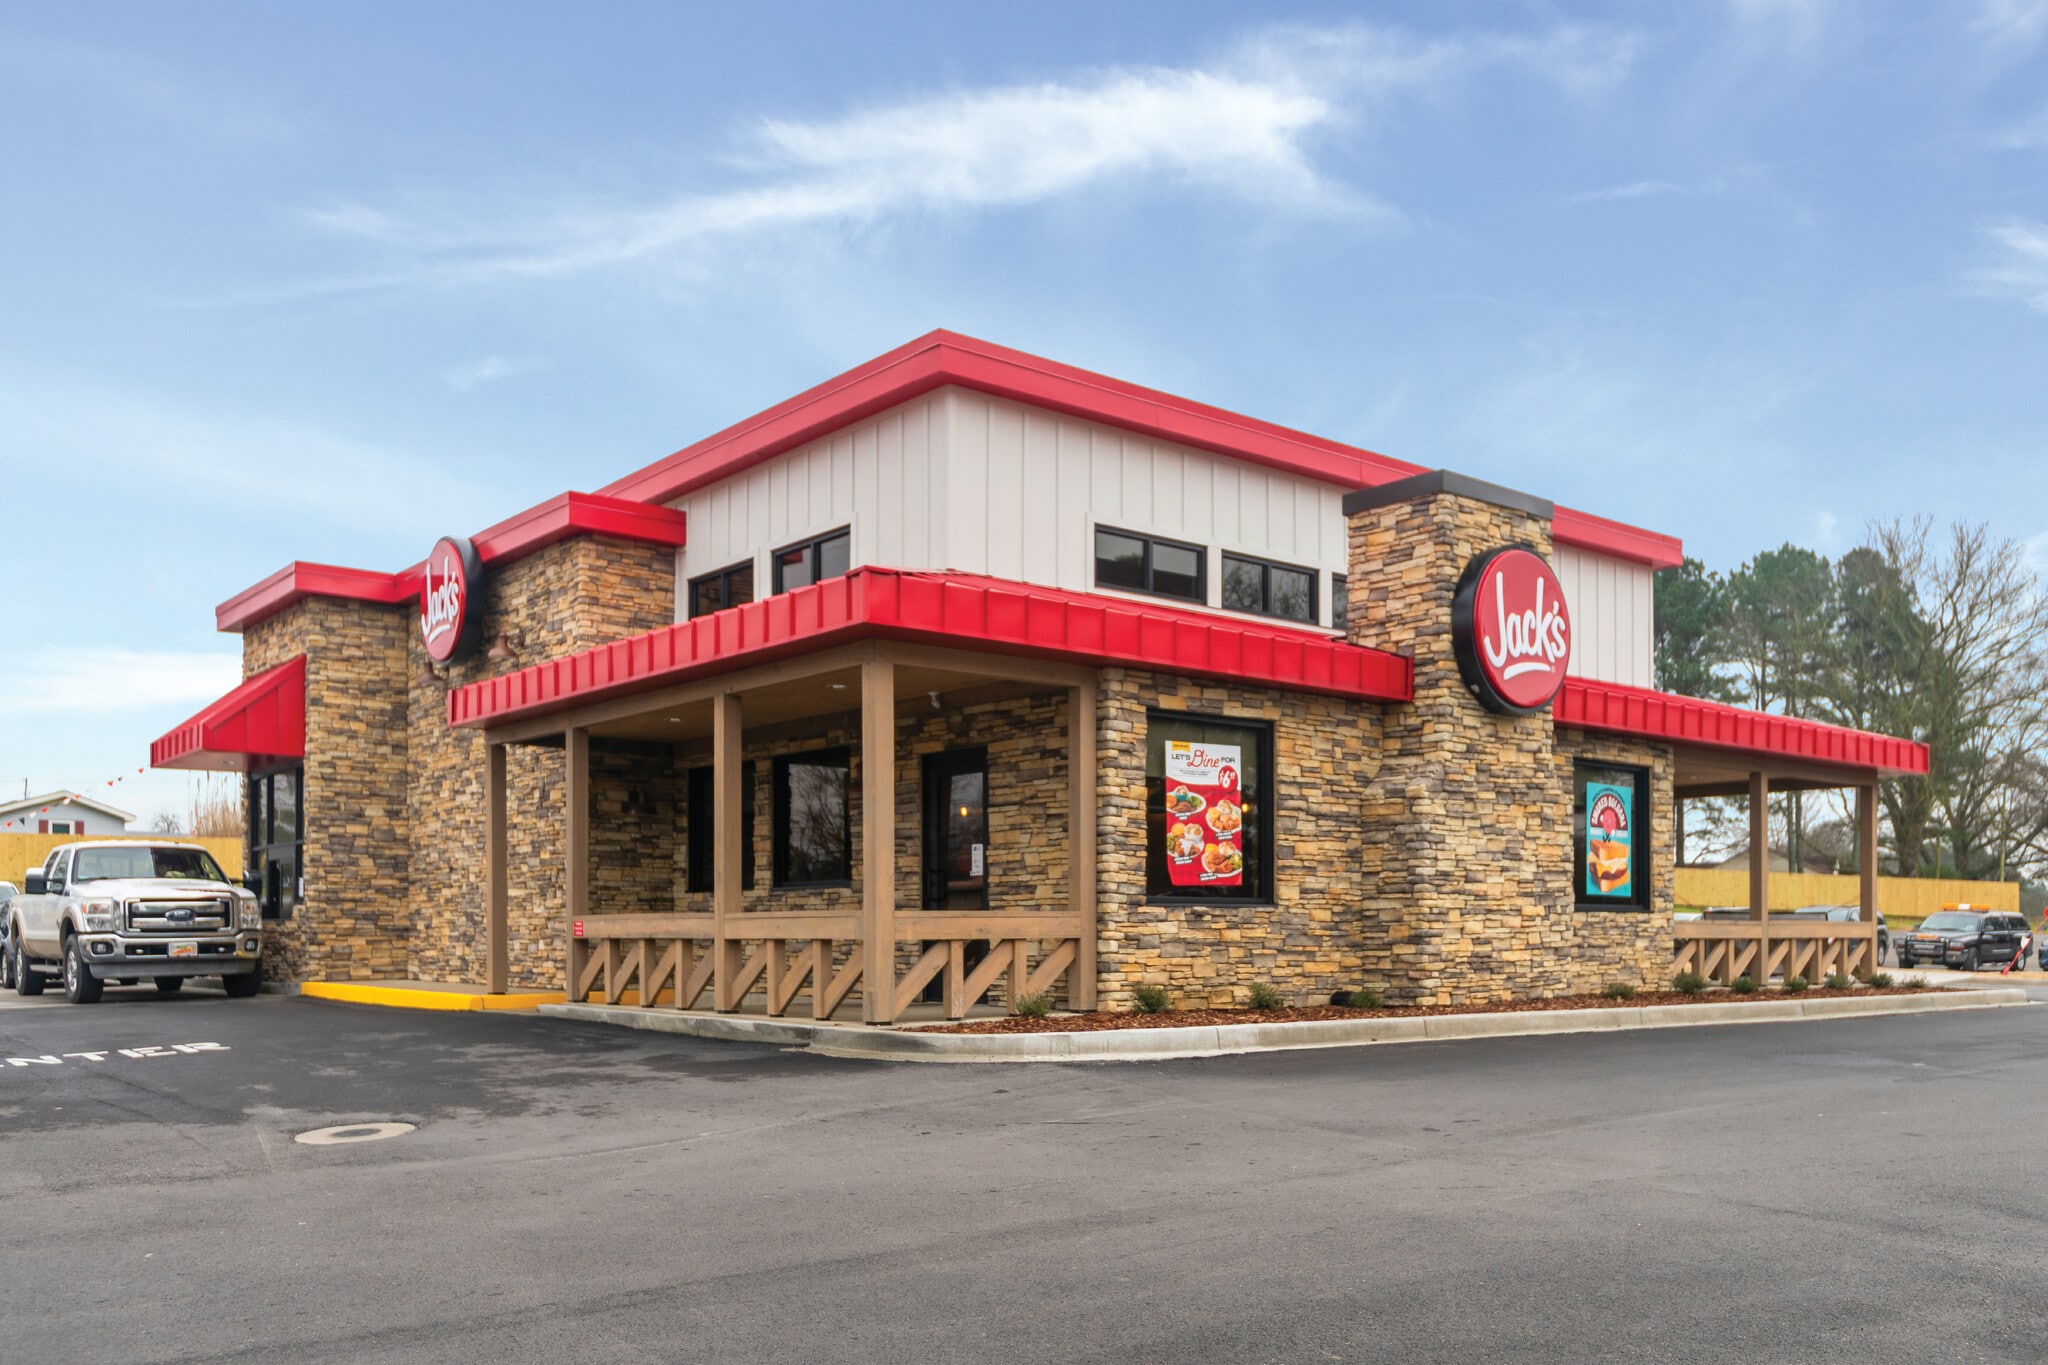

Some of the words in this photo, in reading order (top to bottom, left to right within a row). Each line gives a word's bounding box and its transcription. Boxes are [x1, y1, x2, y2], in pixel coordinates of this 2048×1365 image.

[421, 556, 459, 636] Jack's
[1484, 571, 1567, 668] Jack's
[1171, 753, 1191, 761] LET'S
[1186, 748, 1221, 768] Dine
[0, 1041, 232, 1068] NTER
